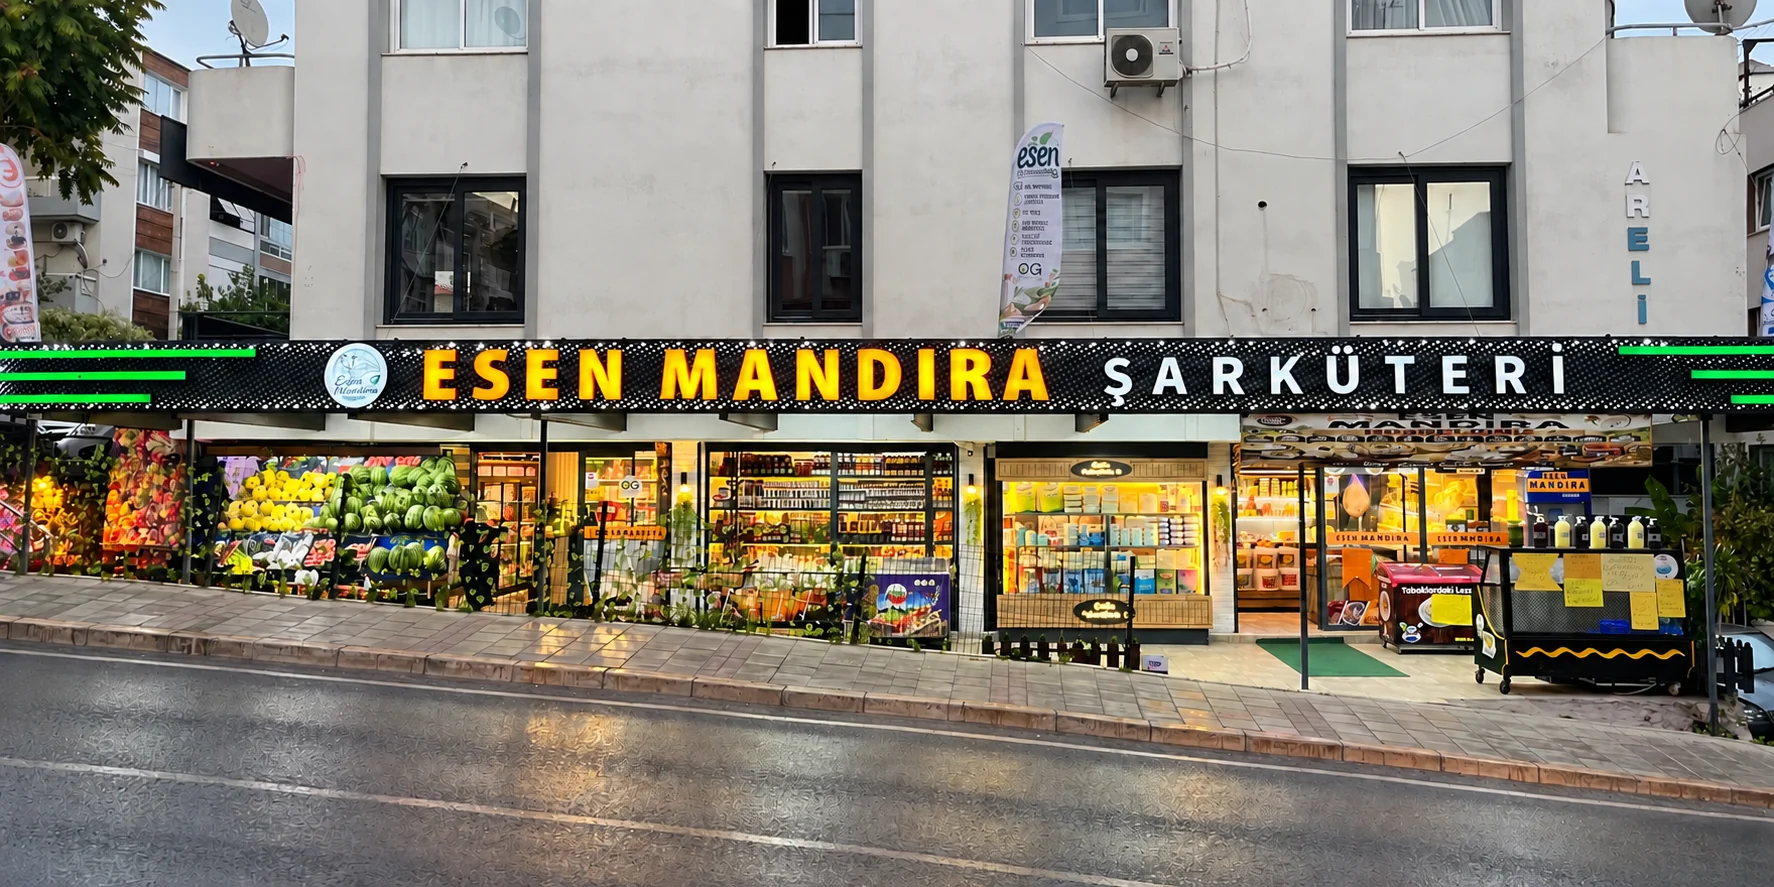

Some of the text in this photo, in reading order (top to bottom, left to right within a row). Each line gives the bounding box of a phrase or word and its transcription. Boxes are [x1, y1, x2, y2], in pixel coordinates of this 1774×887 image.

[1017, 145, 1060, 169] esen
[1018, 262, 1042, 276] OG
[422, 348, 1049, 401] ESEN MANDIRA
[1104, 343, 1565, 407] ŞARKÜTERİ
[1529, 481, 1585, 489] MANDIRA
